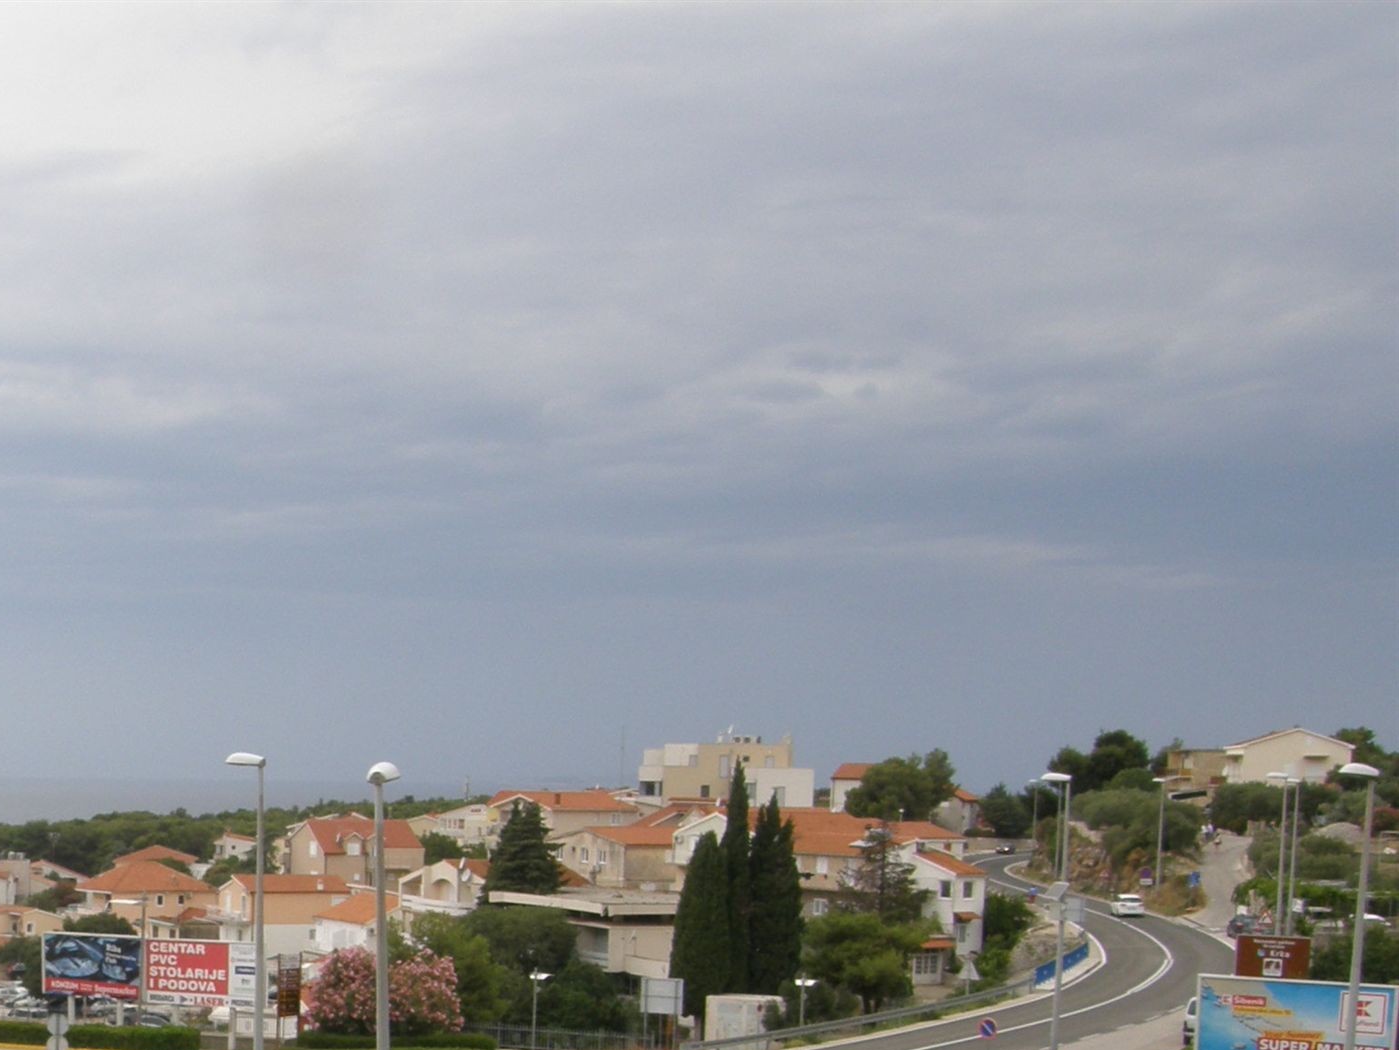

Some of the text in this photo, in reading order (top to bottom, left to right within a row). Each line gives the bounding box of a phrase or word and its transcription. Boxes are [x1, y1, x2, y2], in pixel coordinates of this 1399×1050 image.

[150, 942, 206, 955] CENTAR
[150, 954, 177, 966] PVC
[149, 966, 226, 981] STOLARIJE
[150, 979, 216, 992] I PODOVA
[193, 996, 224, 1007] LASER
